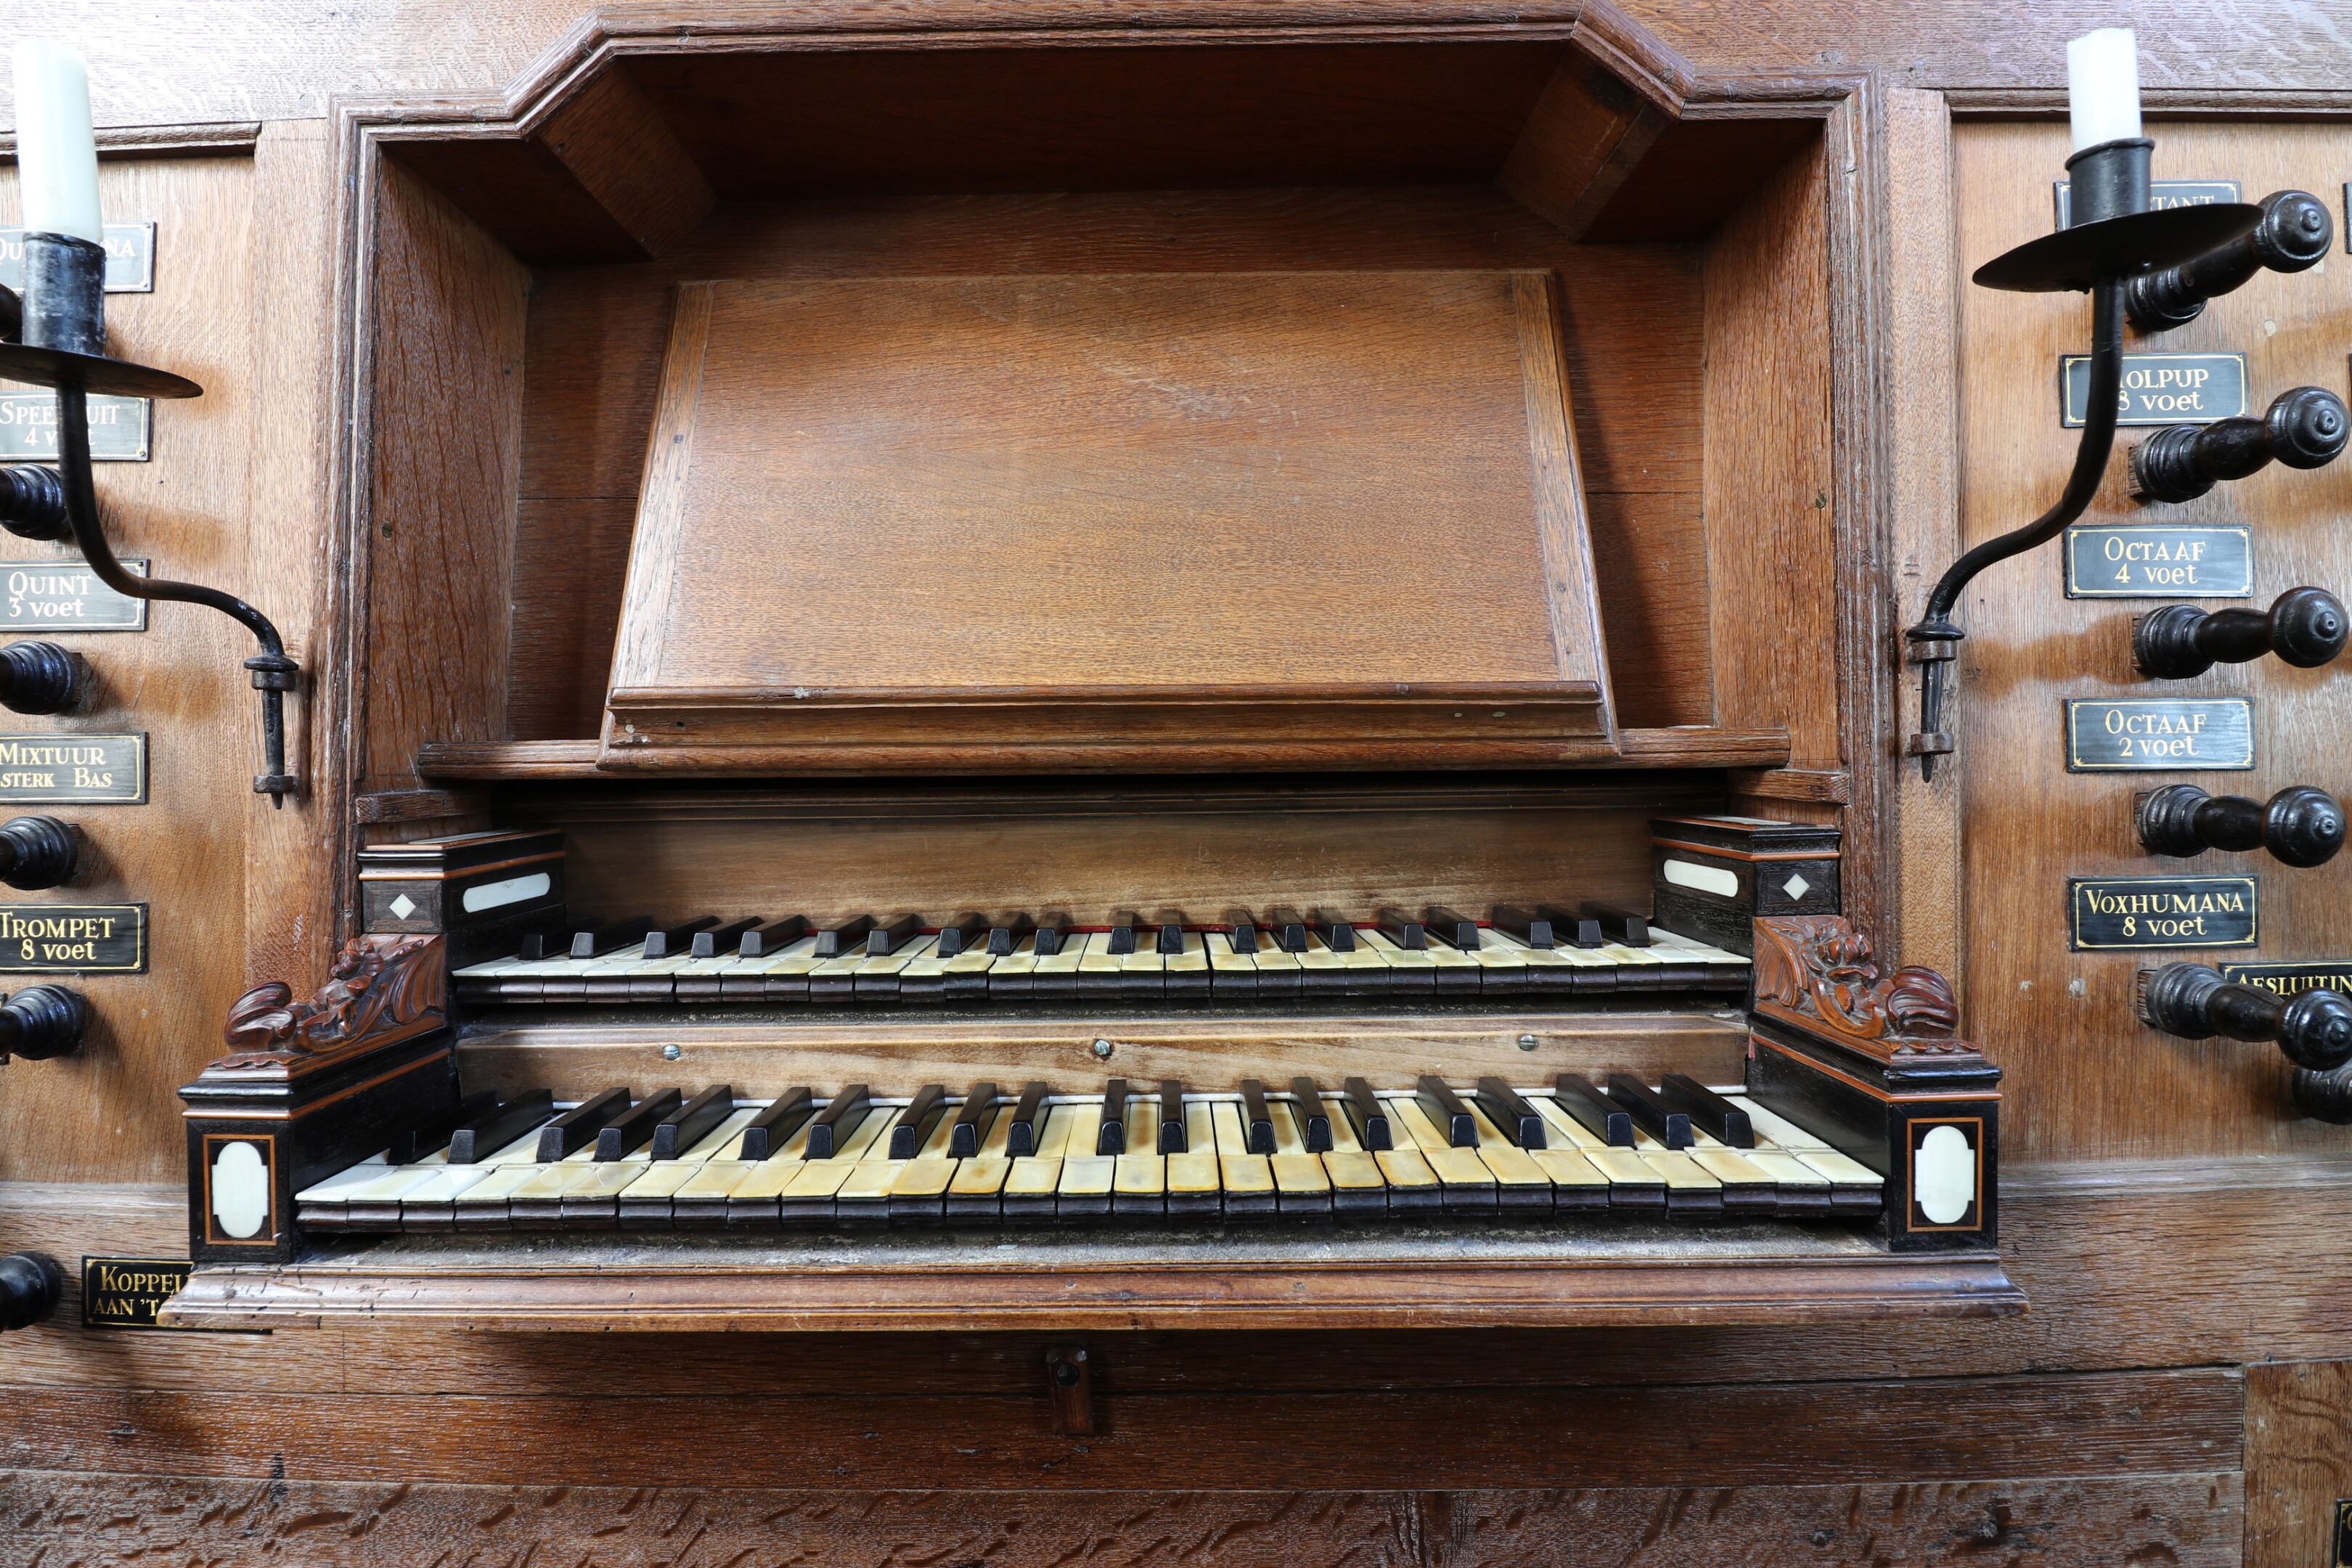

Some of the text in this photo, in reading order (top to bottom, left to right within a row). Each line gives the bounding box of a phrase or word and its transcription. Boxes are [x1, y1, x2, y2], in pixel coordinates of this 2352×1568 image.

[2118, 390, 2204, 411] 8 voet
[24, 427, 97, 446] 4 vt
[2104, 536, 2206, 561] OCTAAF
[2114, 563, 2199, 584] 4 voet
[8, 571, 92, 601] QUINT
[9, 597, 85, 617] 3 voet
[2104, 709, 2207, 735] OCTAAF
[0, 743, 107, 766] MIXTUUR
[2118, 735, 2200, 757] 2 voet
[0, 767, 113, 788] STERK BAS
[2084, 889, 2245, 915] VOXHUMANA
[0, 910, 115, 939] TROMPET
[2122, 915, 2208, 937] 8 voet
[20, 939, 97, 960] 8 voet
[92, 1297, 135, 1317] AAN
